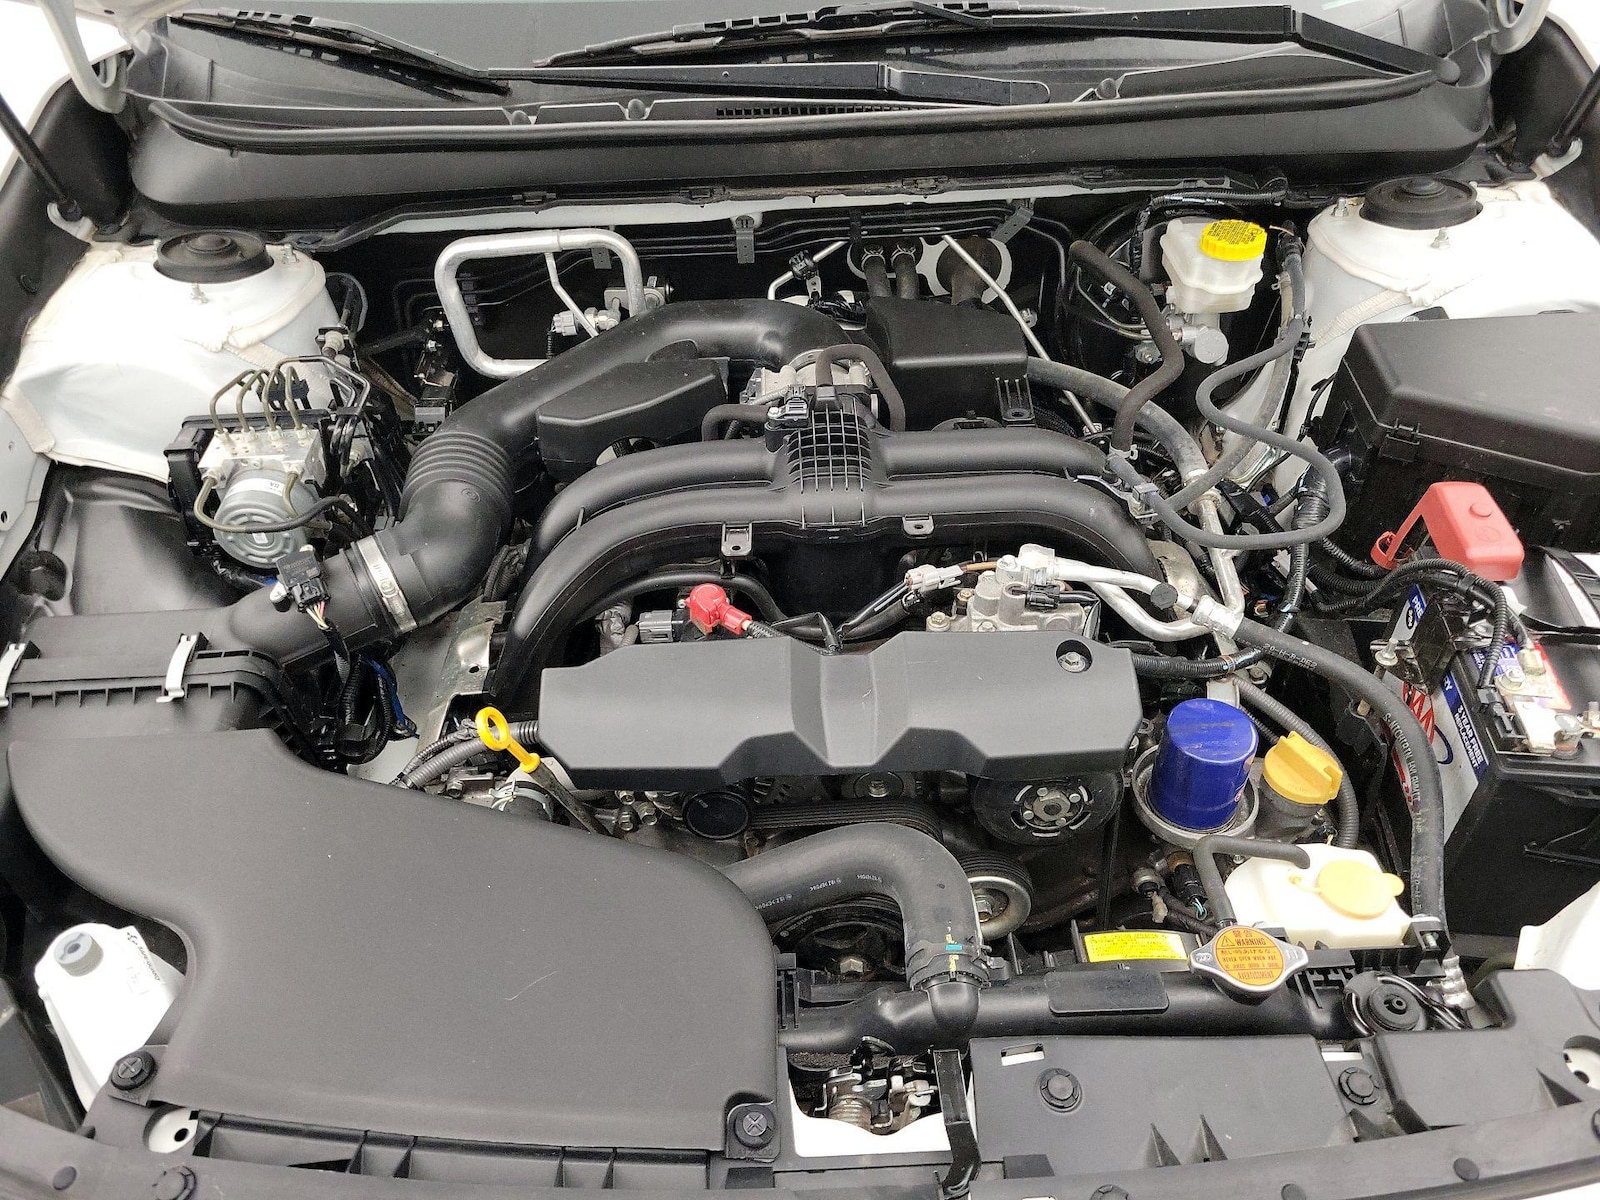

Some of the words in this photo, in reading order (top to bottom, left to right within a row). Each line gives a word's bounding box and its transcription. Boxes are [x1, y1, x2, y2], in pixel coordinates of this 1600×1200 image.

[1460, 711, 1474, 740] YEAR
[1469, 737, 1485, 764] FREE
[1234, 938, 1267, 947] WARNING
